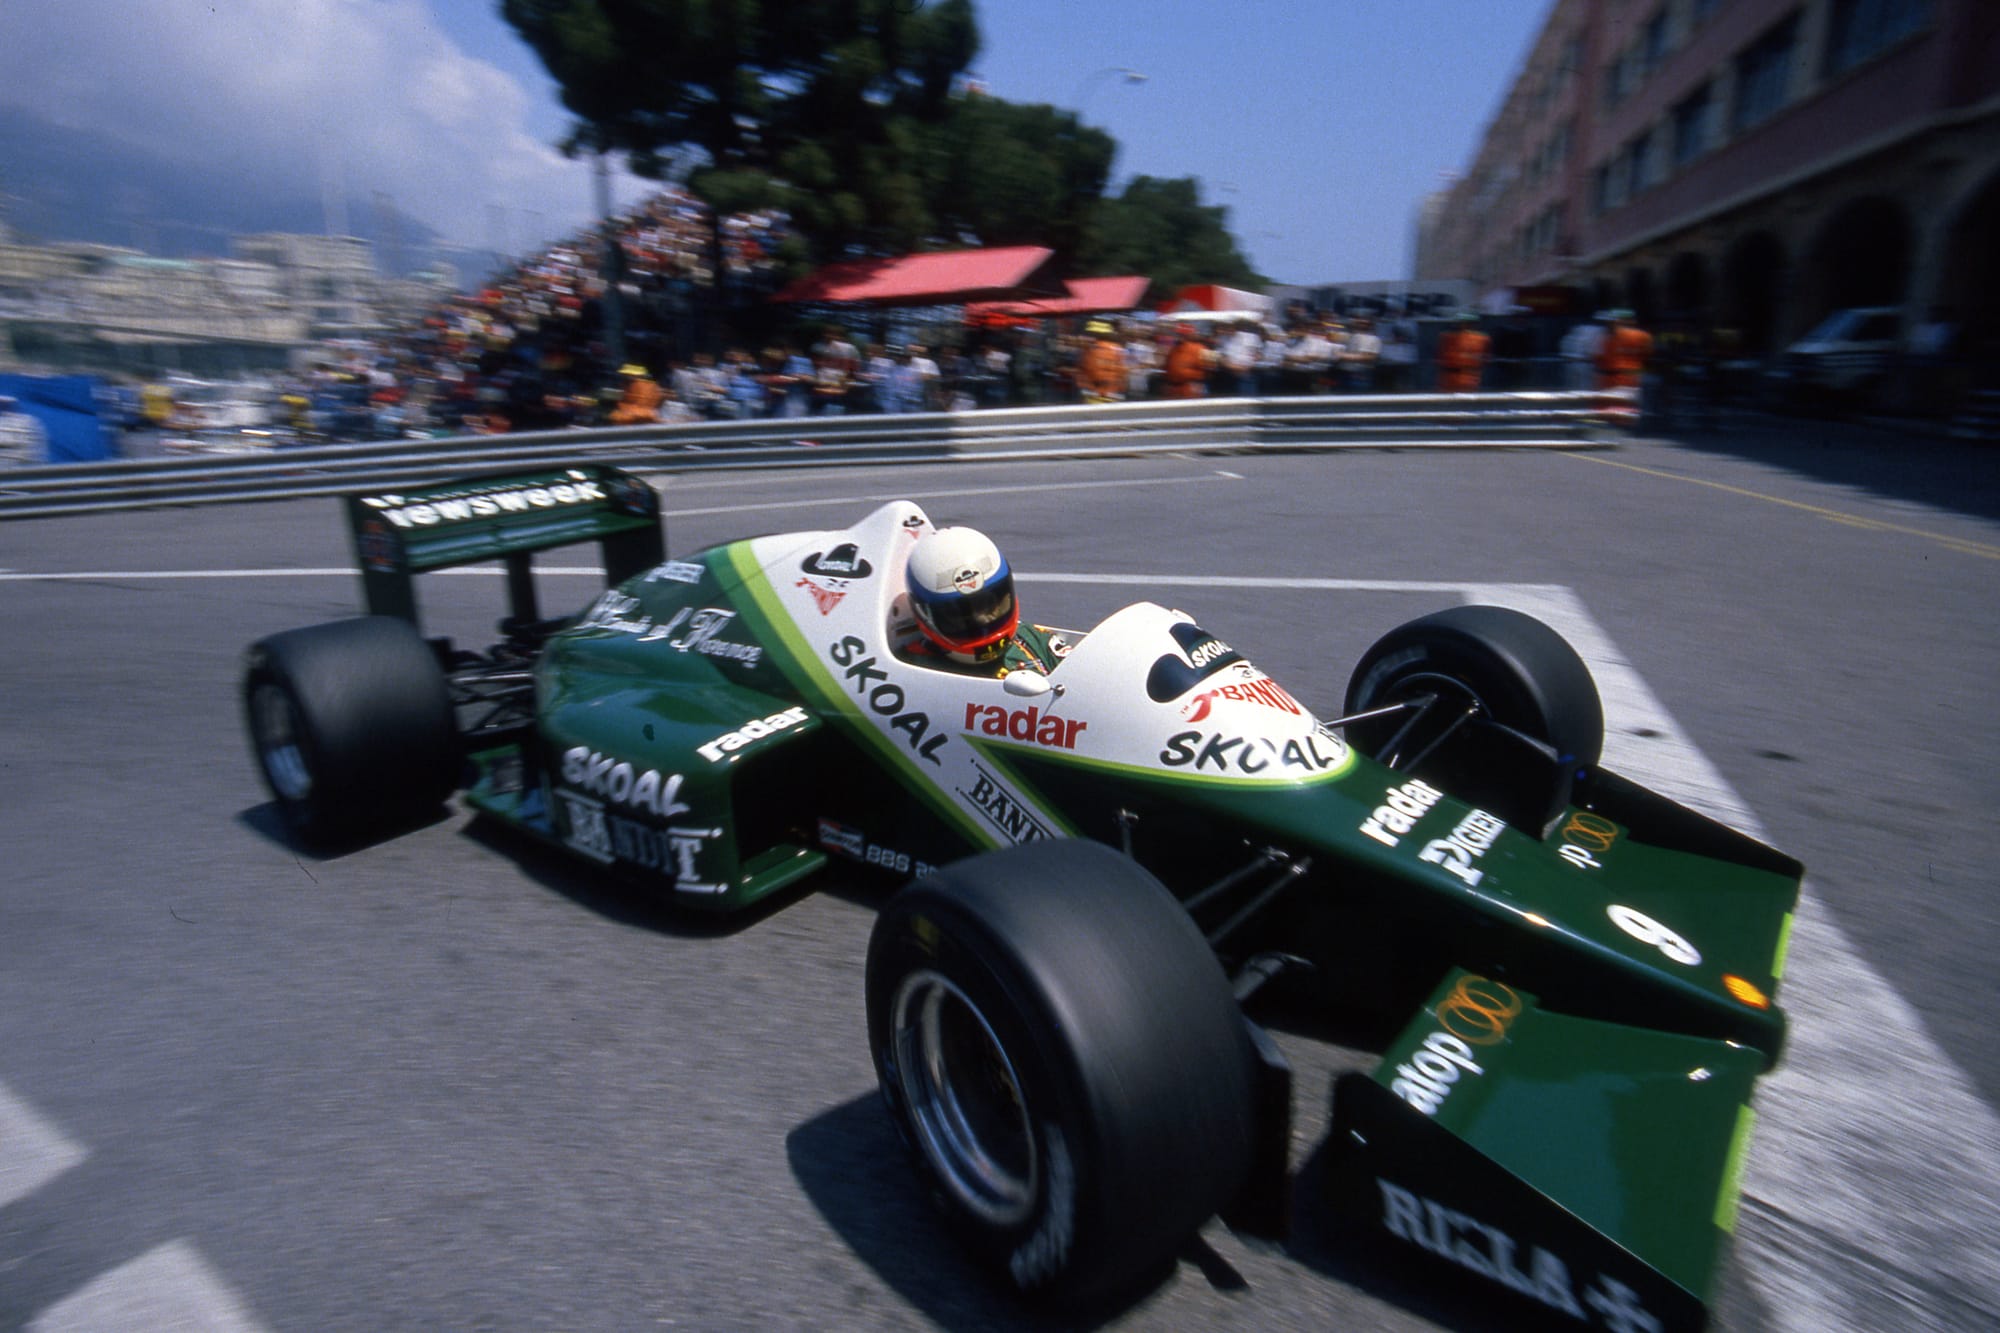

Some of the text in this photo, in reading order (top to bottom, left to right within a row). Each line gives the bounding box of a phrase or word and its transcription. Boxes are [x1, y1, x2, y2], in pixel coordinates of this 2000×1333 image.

[830, 635, 949, 767] SKOAL
[965, 702, 1088, 749] radar
[697, 705, 809, 763] radar
[1159, 731, 1335, 774] SKOAL
[562, 746, 691, 817] SKOAL
[1359, 778, 1444, 848] radar
[1606, 904, 1702, 966] 9
